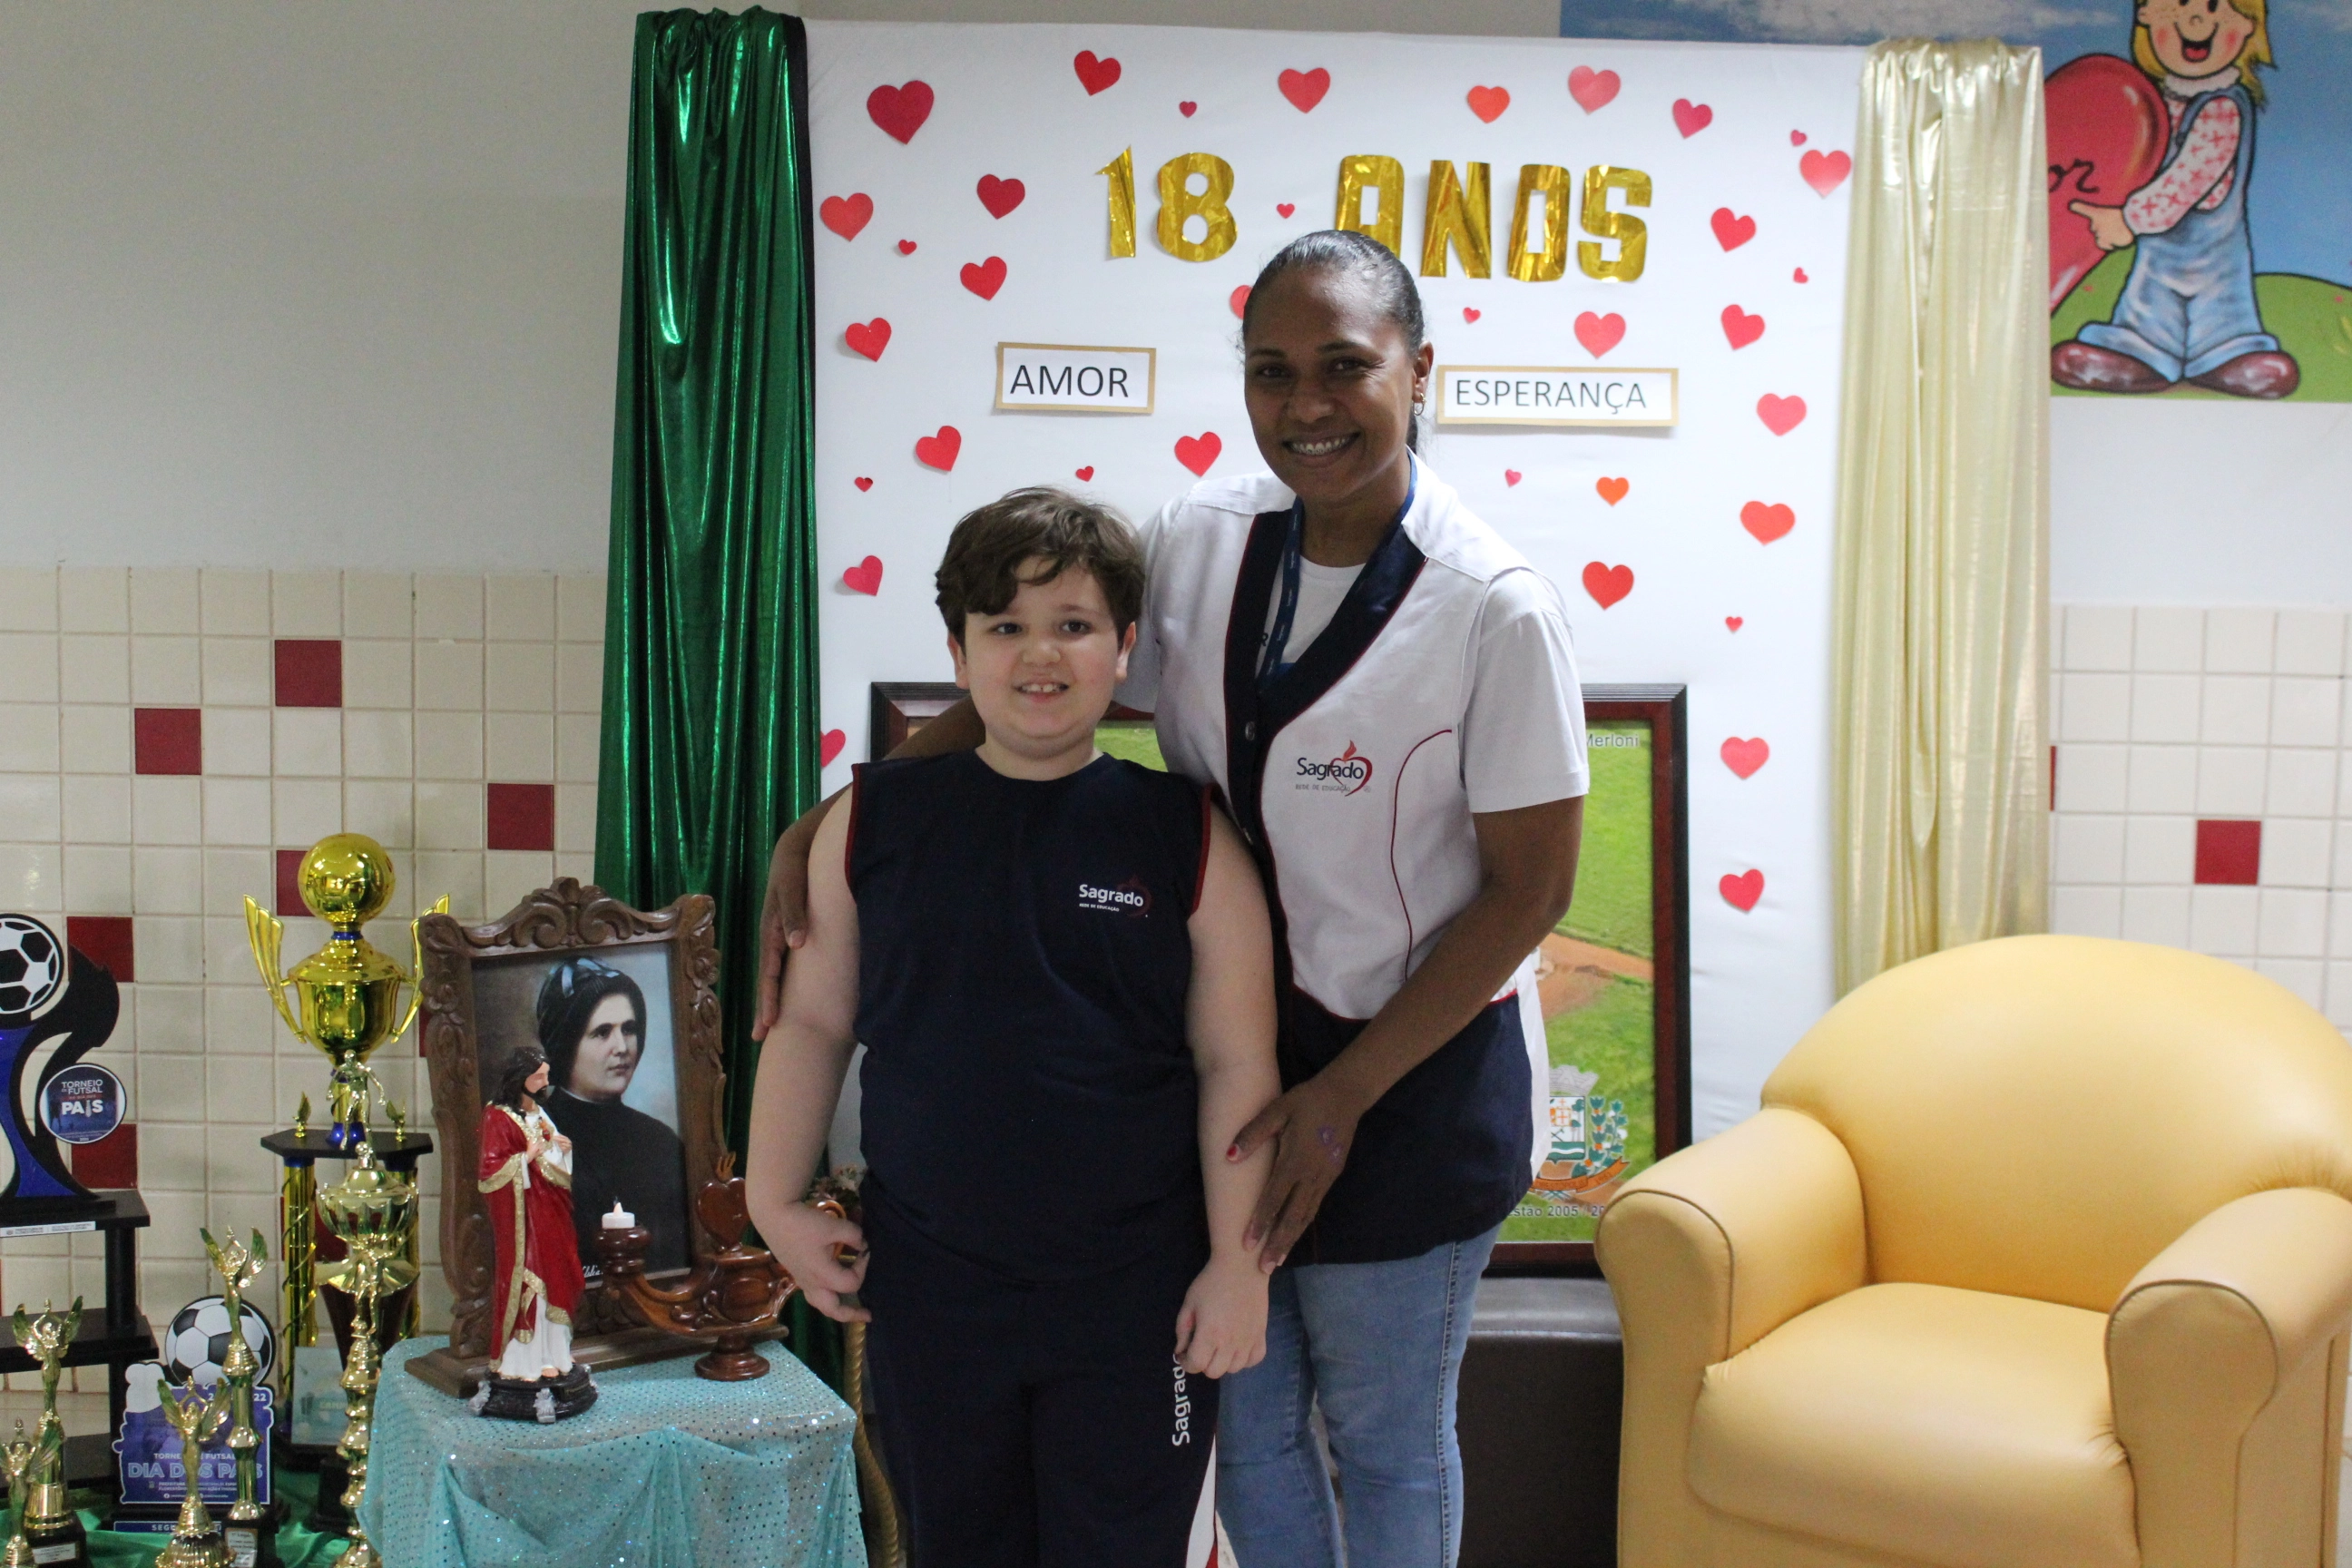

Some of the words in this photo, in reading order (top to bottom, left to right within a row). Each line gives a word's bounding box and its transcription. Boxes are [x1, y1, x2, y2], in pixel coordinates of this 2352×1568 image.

[1095, 145, 1238, 262] 18
[1334, 153, 1653, 284] ANOS
[1009, 364, 1130, 399] AMOR
[1455, 378, 1648, 416] ESPERANÇA
[1297, 757, 1364, 780] Sagrado
[1079, 884, 1143, 906] Sagrado
[62, 1079, 103, 1089] TORNEIO
[68, 1086, 103, 1094] FUTSAL
[1510, 1205, 1543, 1217] stão
[1548, 1205, 1578, 1217] 2005
[128, 1462, 165, 1478] DIA
[170, 1462, 213, 1479] DS
